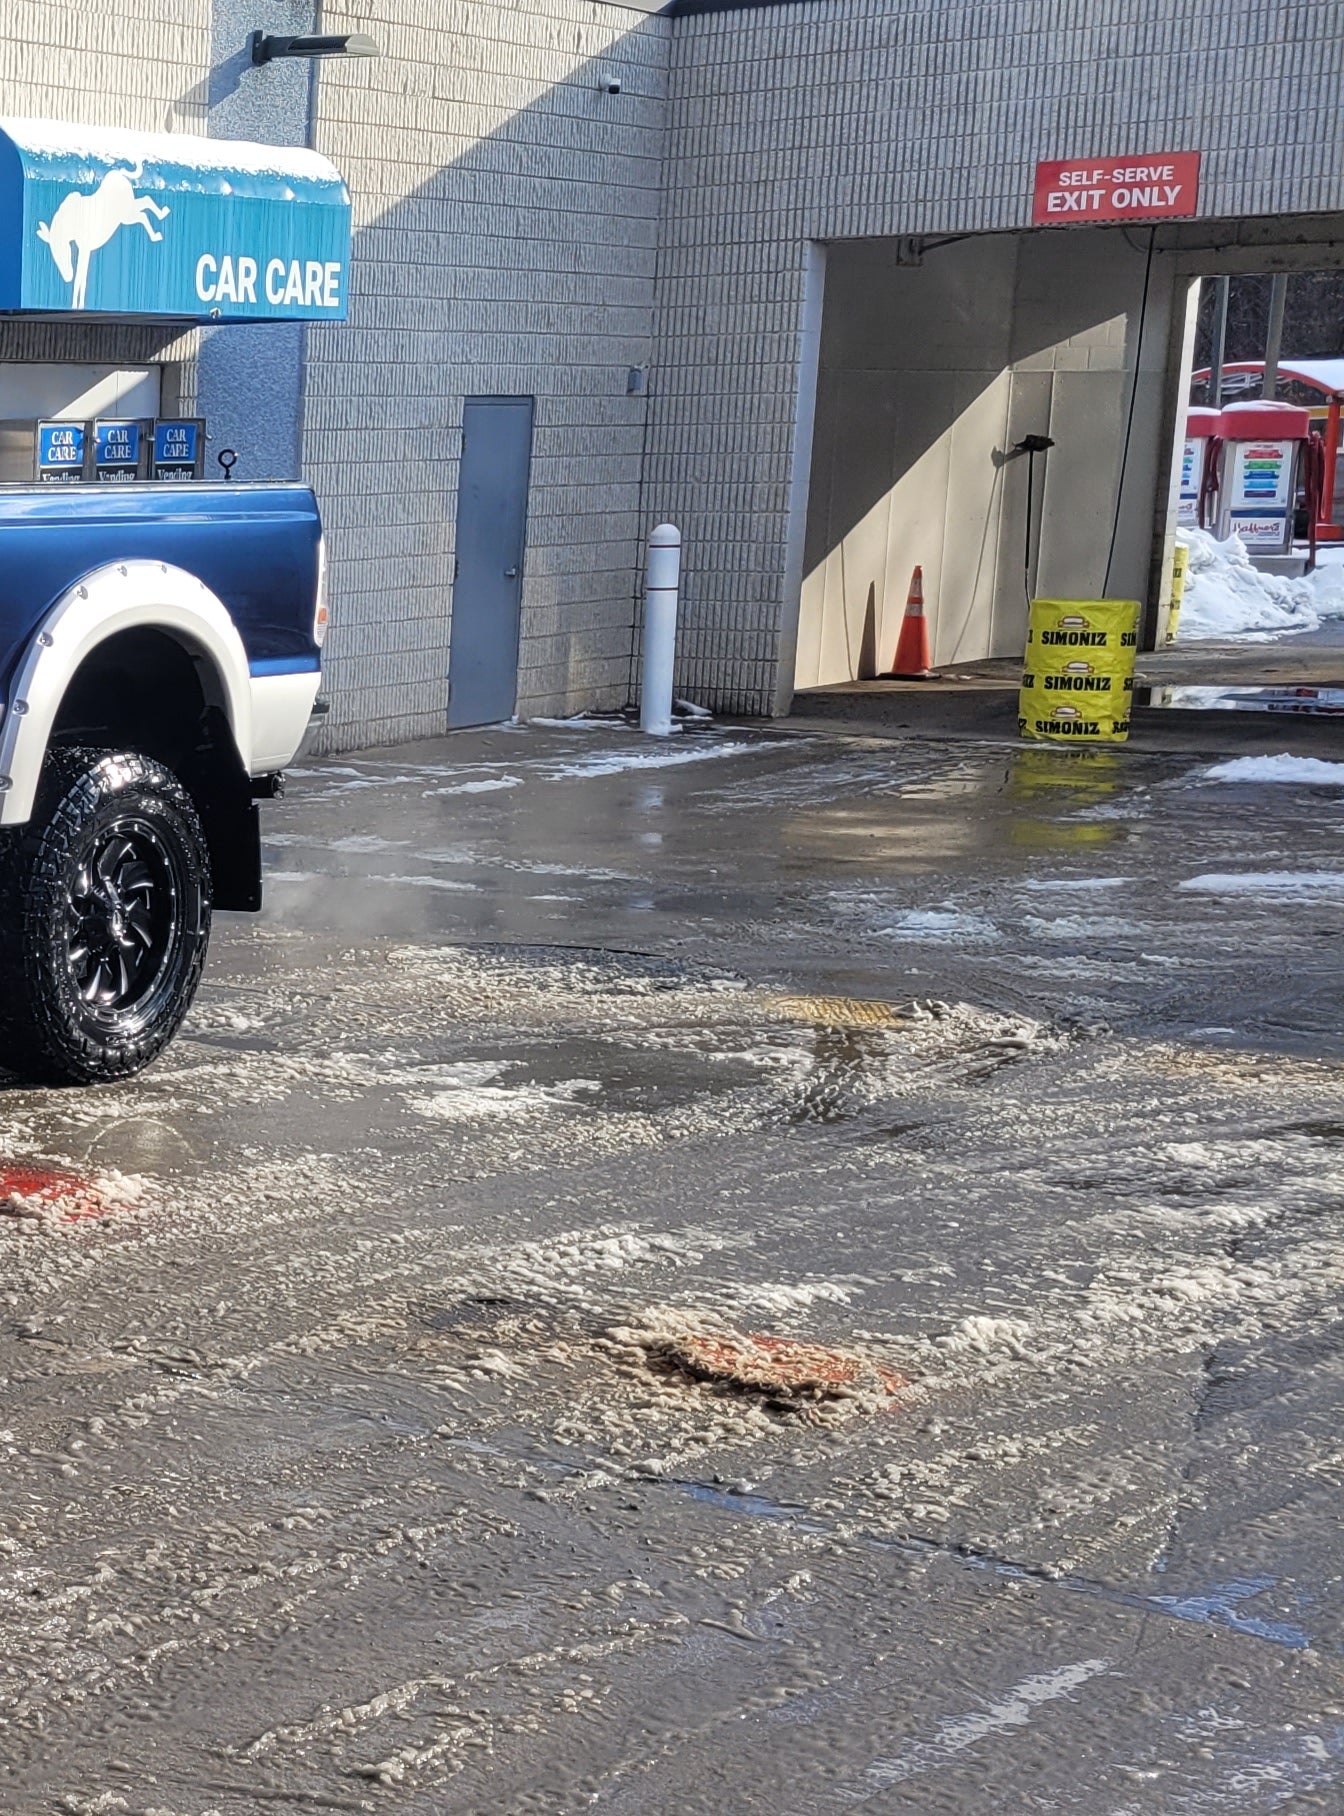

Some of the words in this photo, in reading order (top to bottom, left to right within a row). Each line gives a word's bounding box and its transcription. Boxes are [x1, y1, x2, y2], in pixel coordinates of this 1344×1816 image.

[1058, 165, 1175, 187] SELF-SERVE
[1047, 189, 1107, 212] EXIT
[1111, 185, 1183, 209] ONLY
[195, 253, 257, 303] CAR
[265, 258, 341, 307] CARE
[51, 431, 73, 445] CAR
[107, 430, 129, 443] CAR
[166, 429, 187, 442] CAR
[47, 446, 77, 462] CARE
[104, 445, 132, 459] CARE
[162, 444, 189, 458] CARE
[1041, 630, 1108, 646] SIMONIZ
[1044, 675, 1111, 691] SIMONIZ
[1035, 720, 1101, 735] SIMONIZ
